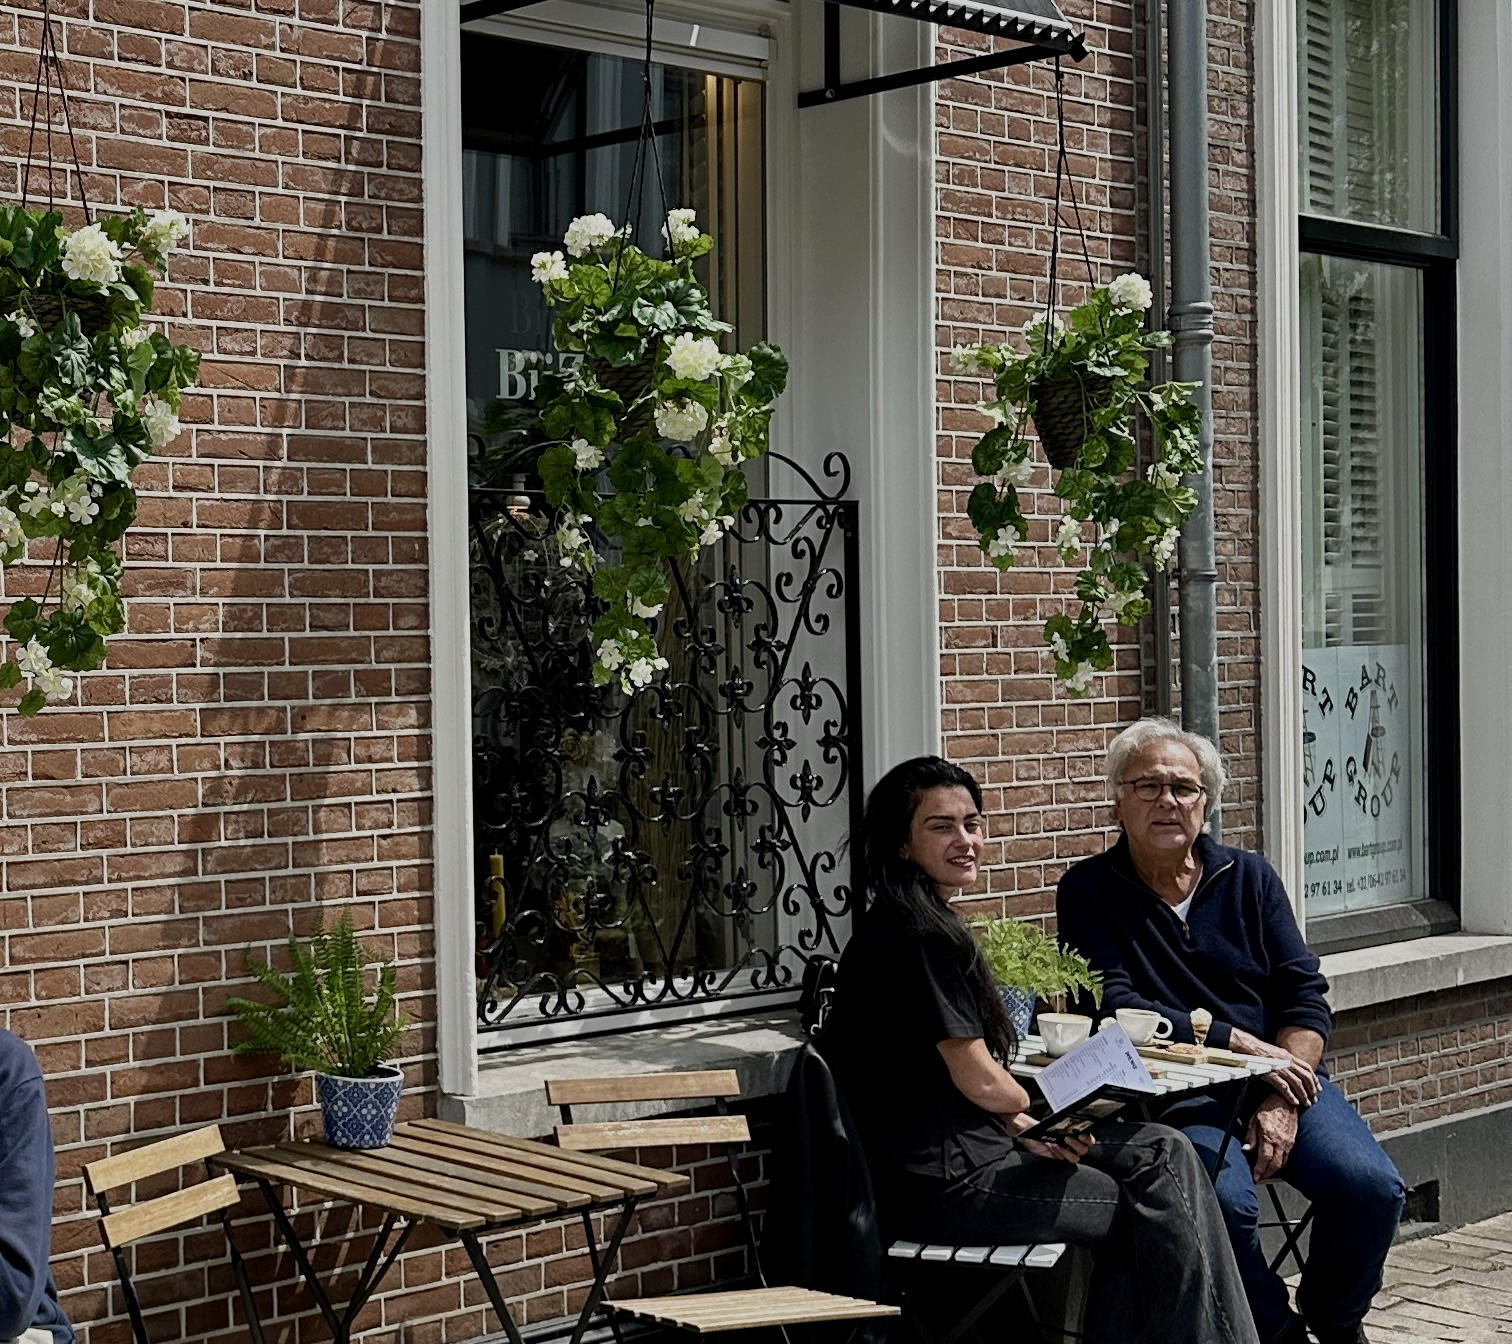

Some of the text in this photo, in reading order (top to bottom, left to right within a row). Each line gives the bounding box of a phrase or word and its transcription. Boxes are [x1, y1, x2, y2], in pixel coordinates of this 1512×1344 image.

[1301, 664, 1334, 719] RT
[1344, 661, 1400, 721] BART
[1345, 751, 1401, 818] GROUP
[1304, 844, 1339, 867] up.com.pl
